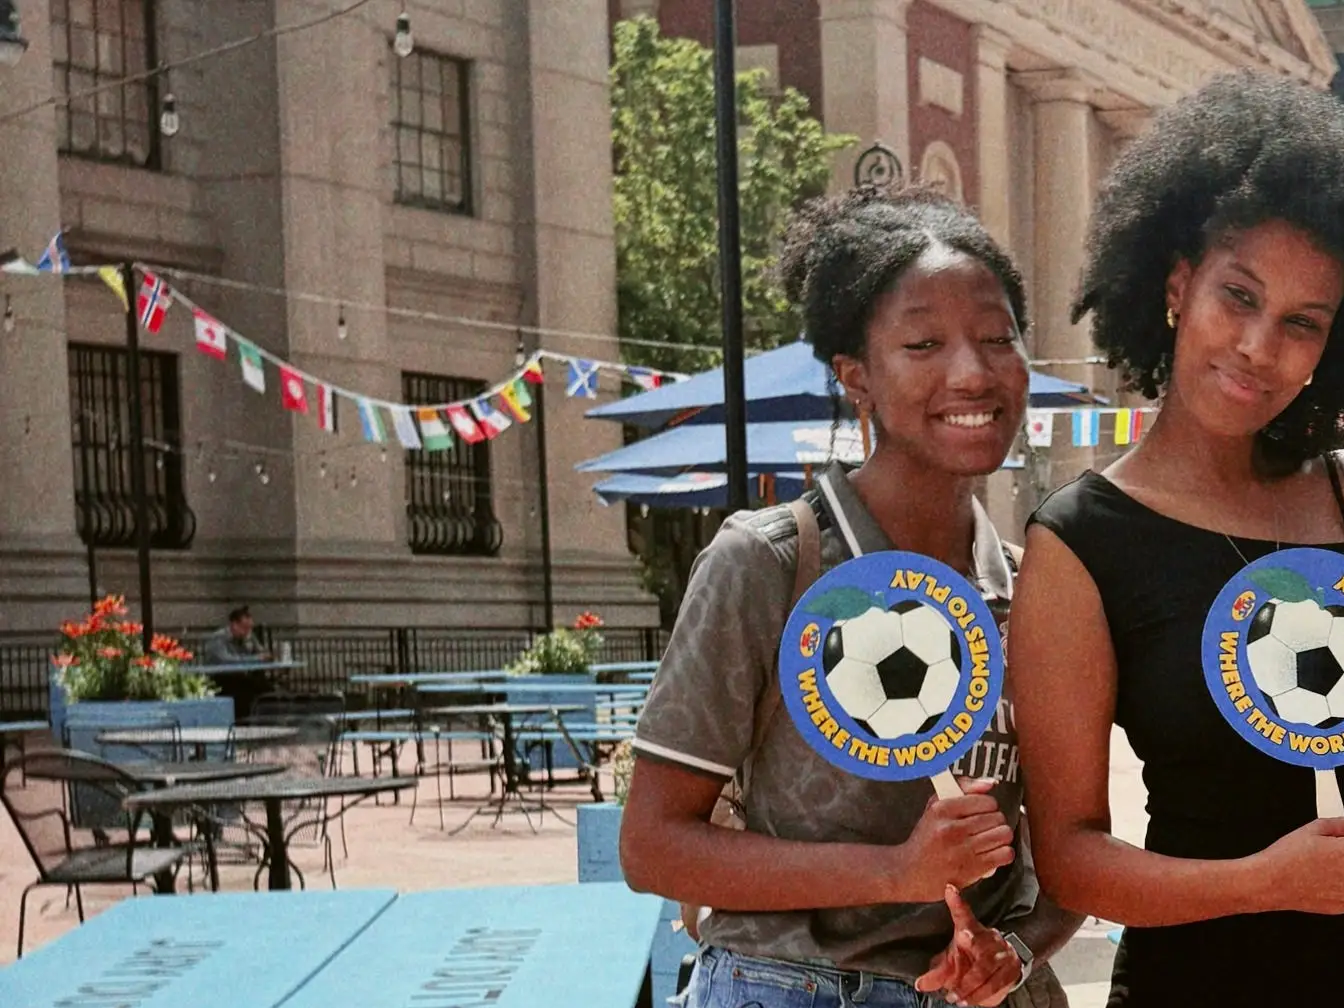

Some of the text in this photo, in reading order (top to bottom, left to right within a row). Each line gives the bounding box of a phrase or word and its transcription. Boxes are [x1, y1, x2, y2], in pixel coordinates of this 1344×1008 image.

[797, 569, 991, 767] WHERE THE WORLD COMES TO PLAY
[1218, 631, 1253, 713] WHERE
[1246, 709, 1289, 744] THE
[952, 739, 1020, 784] ETTER
